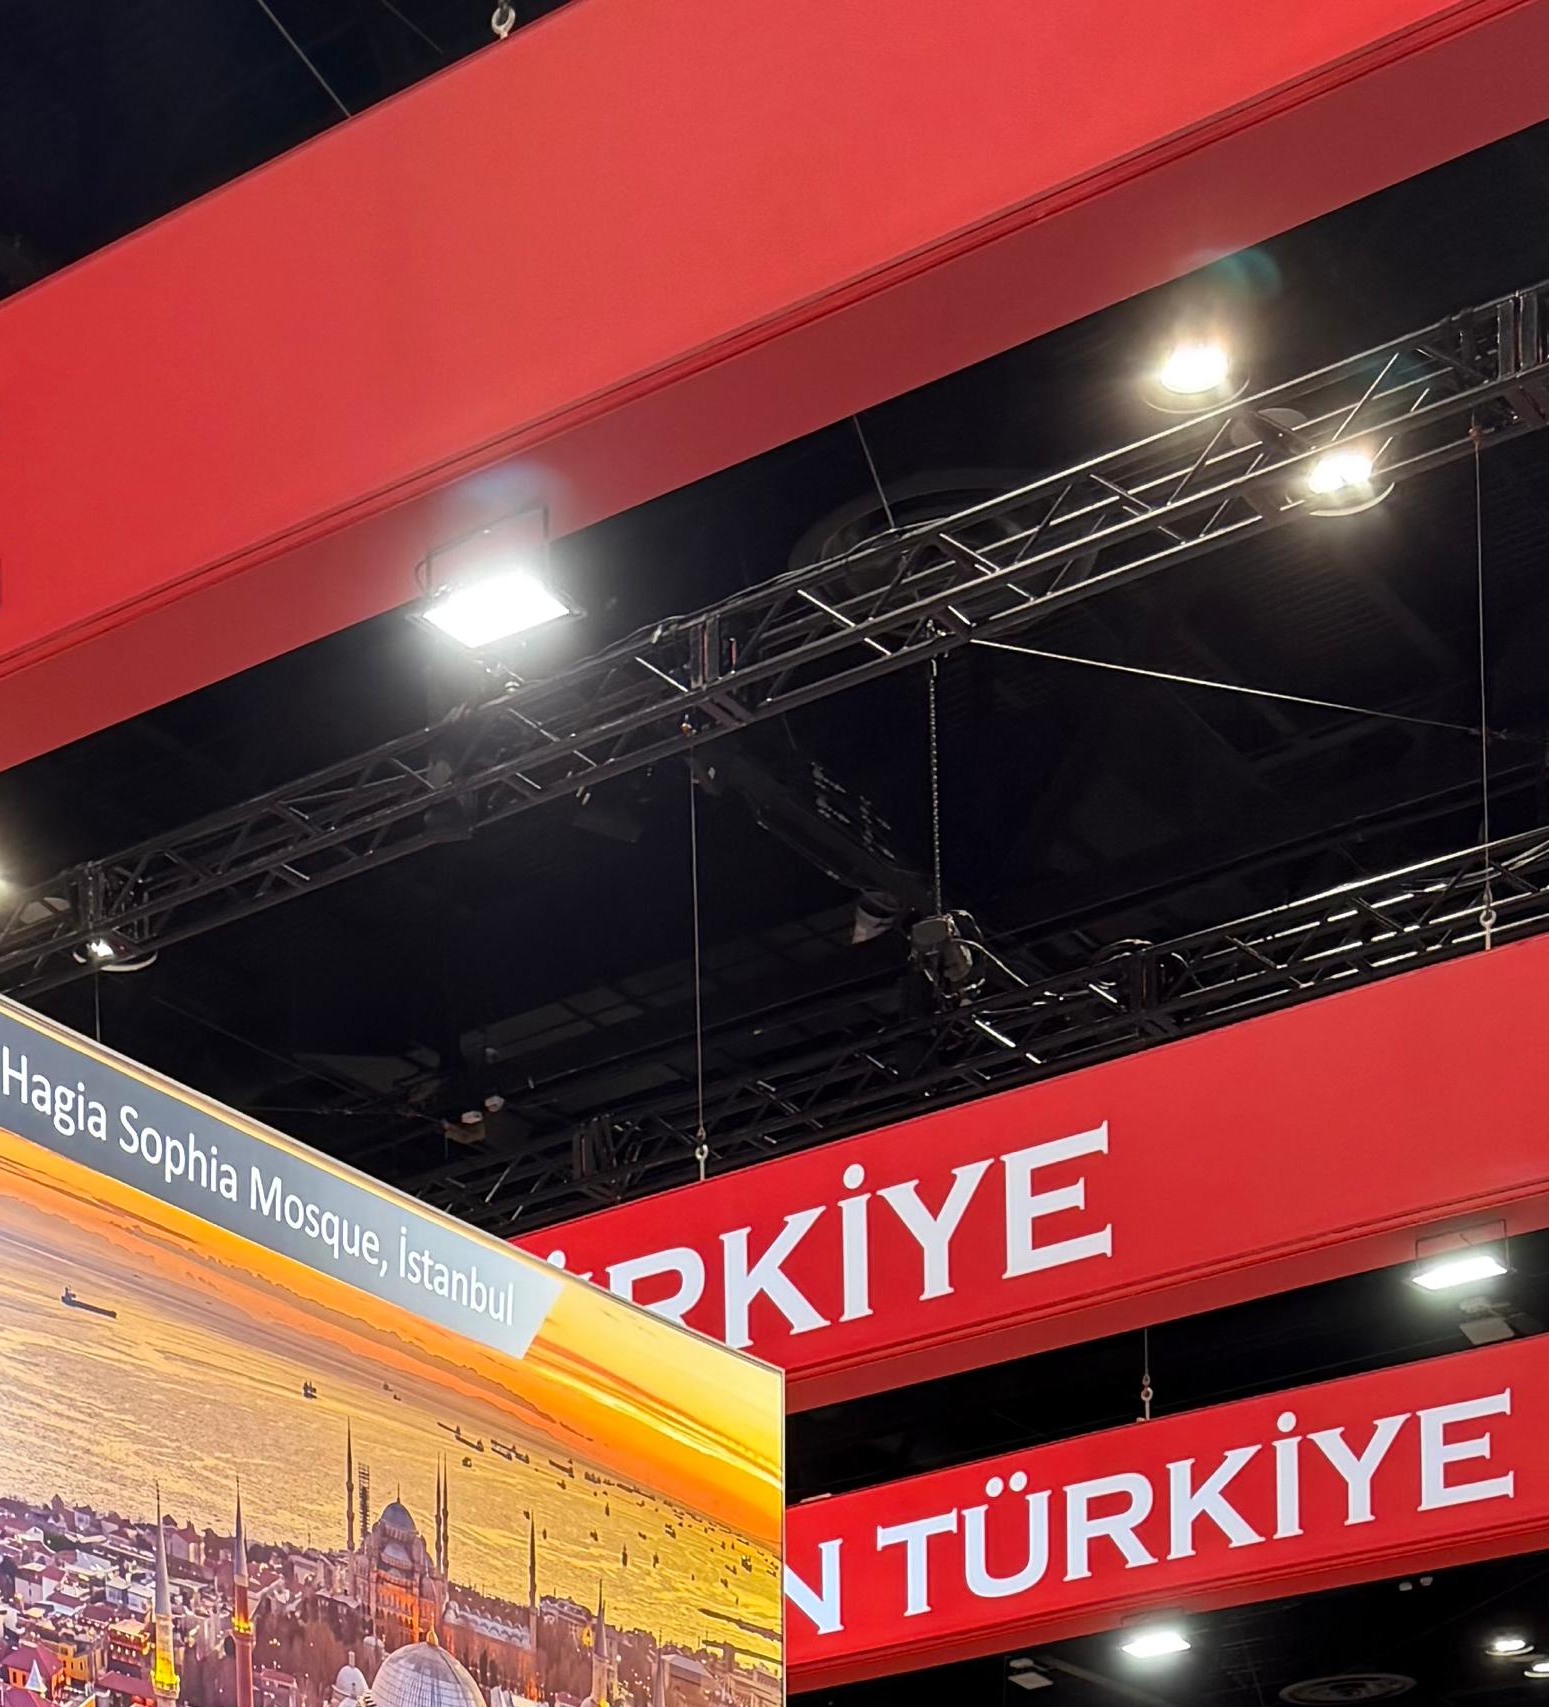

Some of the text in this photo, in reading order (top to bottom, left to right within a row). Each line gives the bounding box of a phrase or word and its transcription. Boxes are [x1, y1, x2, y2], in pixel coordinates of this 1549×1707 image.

[1, 1045, 514, 1326] Hagia Sophia Mosque, İstanbul
[547, 1120, 1113, 1349] RKİYE
[785, 1387, 1514, 1635] N TÜRKİYE
